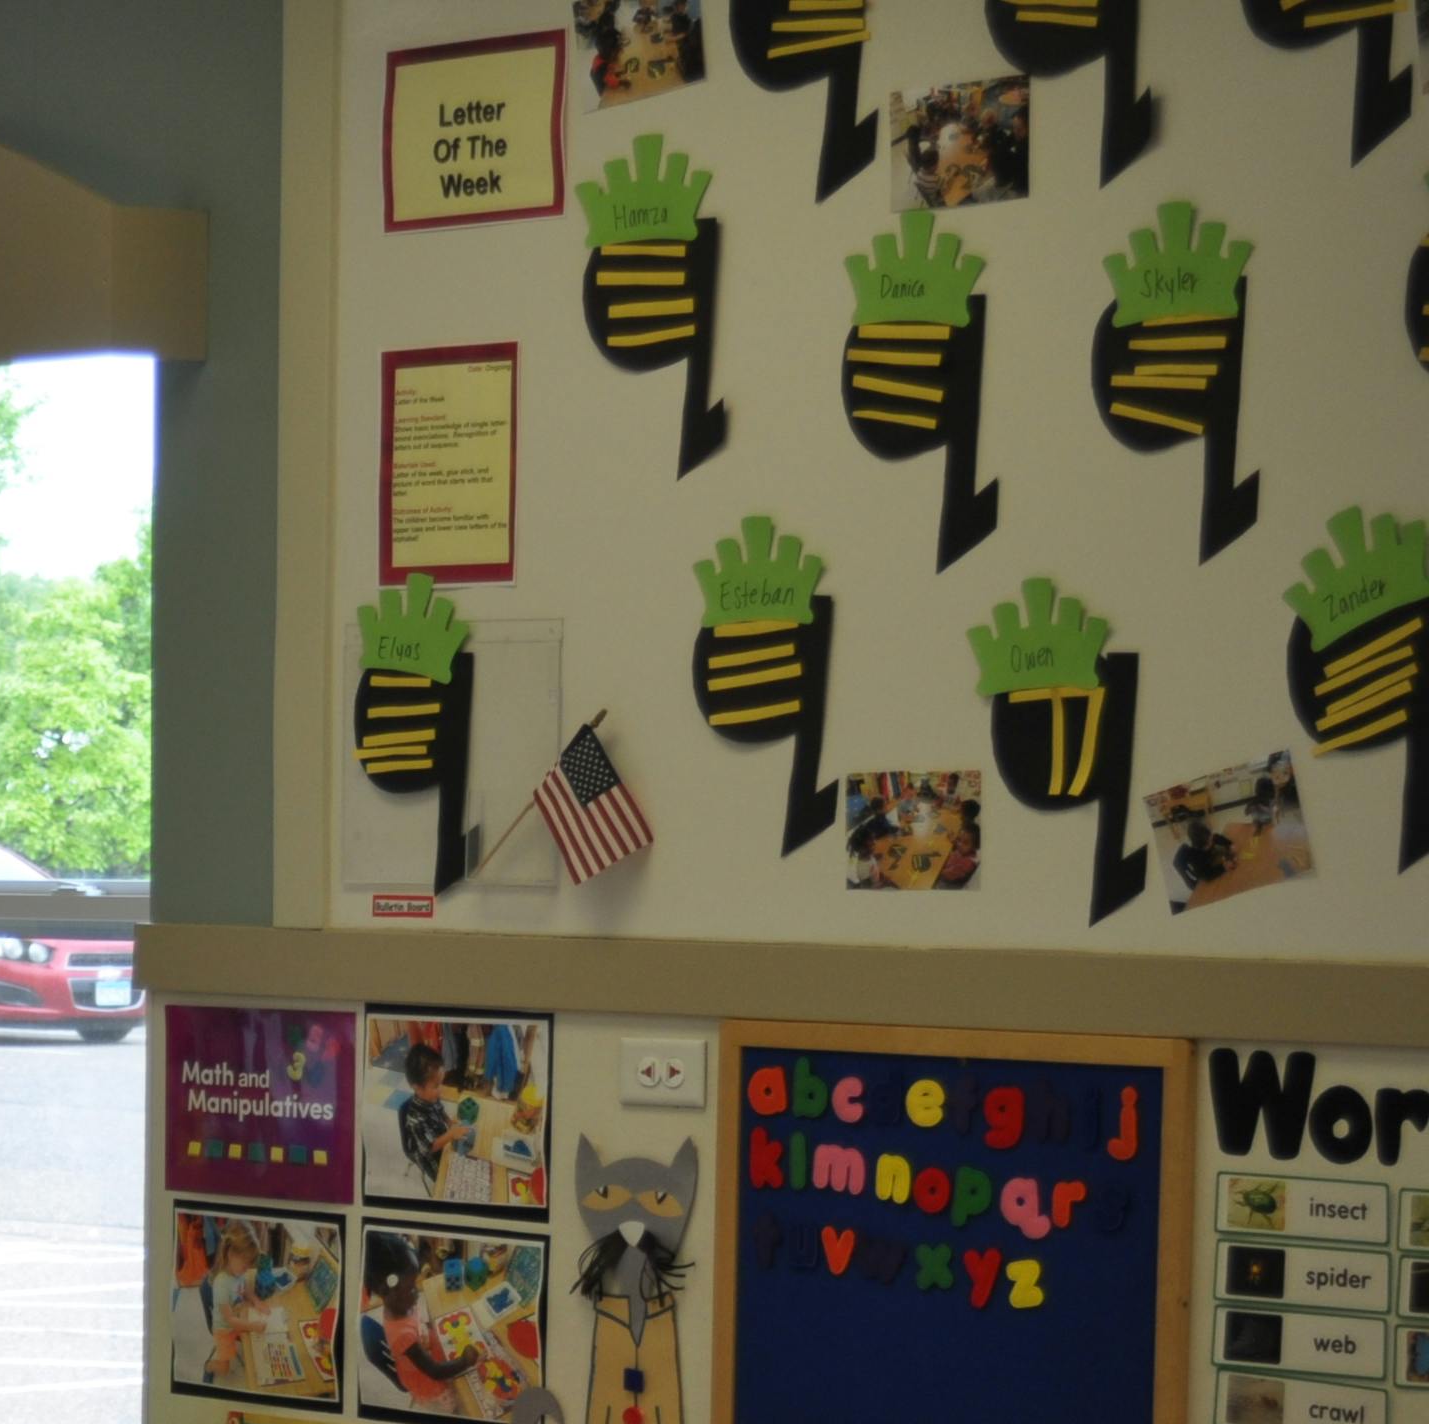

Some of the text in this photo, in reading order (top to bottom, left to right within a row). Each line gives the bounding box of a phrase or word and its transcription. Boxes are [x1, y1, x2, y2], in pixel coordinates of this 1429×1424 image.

[439, 101, 506, 128] Letter
[433, 135, 507, 163] Of The
[440, 170, 502, 198] Week
[613, 204, 668, 232] Hamza
[880, 273, 925, 300] Danica
[1140, 266, 1199, 304] Skyler
[719, 578, 795, 611] Esteban
[1322, 576, 1385, 622] Zander
[378, 636, 421, 661] Elyas
[1010, 644, 1054, 673] Owen
[407, 901, 430, 912] Board
[181, 1060, 271, 1088] Math and
[187, 1088, 334, 1122] Manipulatives
[1208, 1047, 1429, 1168] Wor
[1309, 1196, 1368, 1221] insect
[1305, 1266, 1373, 1291] spider
[1313, 1334, 1357, 1355] web
[1308, 1404, 1366, 1424] crawl
